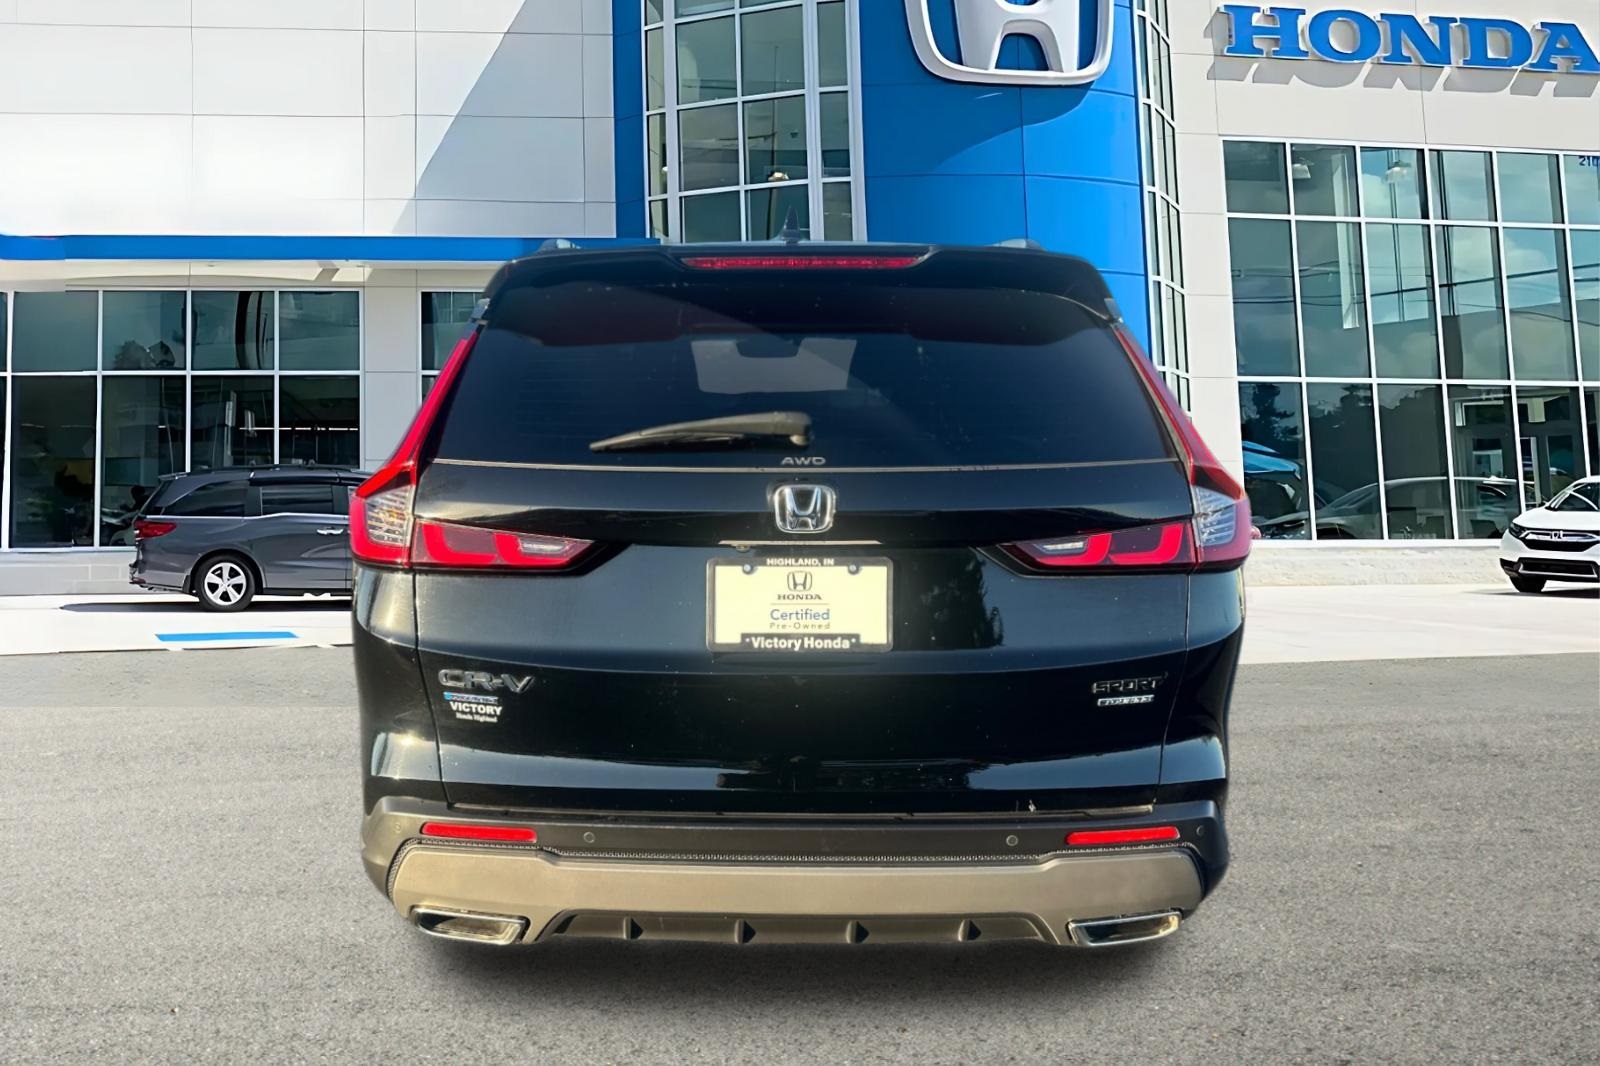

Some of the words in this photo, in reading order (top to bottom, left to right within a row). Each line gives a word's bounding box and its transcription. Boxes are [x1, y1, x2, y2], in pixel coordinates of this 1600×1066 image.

[1222, 4, 1600, 73] HONDA
[781, 457, 826, 465] AWD
[766, 558, 821, 566] HIGHLAND,
[823, 558, 835, 566] IN
[770, 608, 830, 621] Certified
[769, 622, 831, 630] Pre-Owned
[751, 637, 801, 651] Victory
[804, 637, 850, 648] Honda
[439, 669, 535, 693] CR-V
[450, 702, 502, 715] VICTORY
